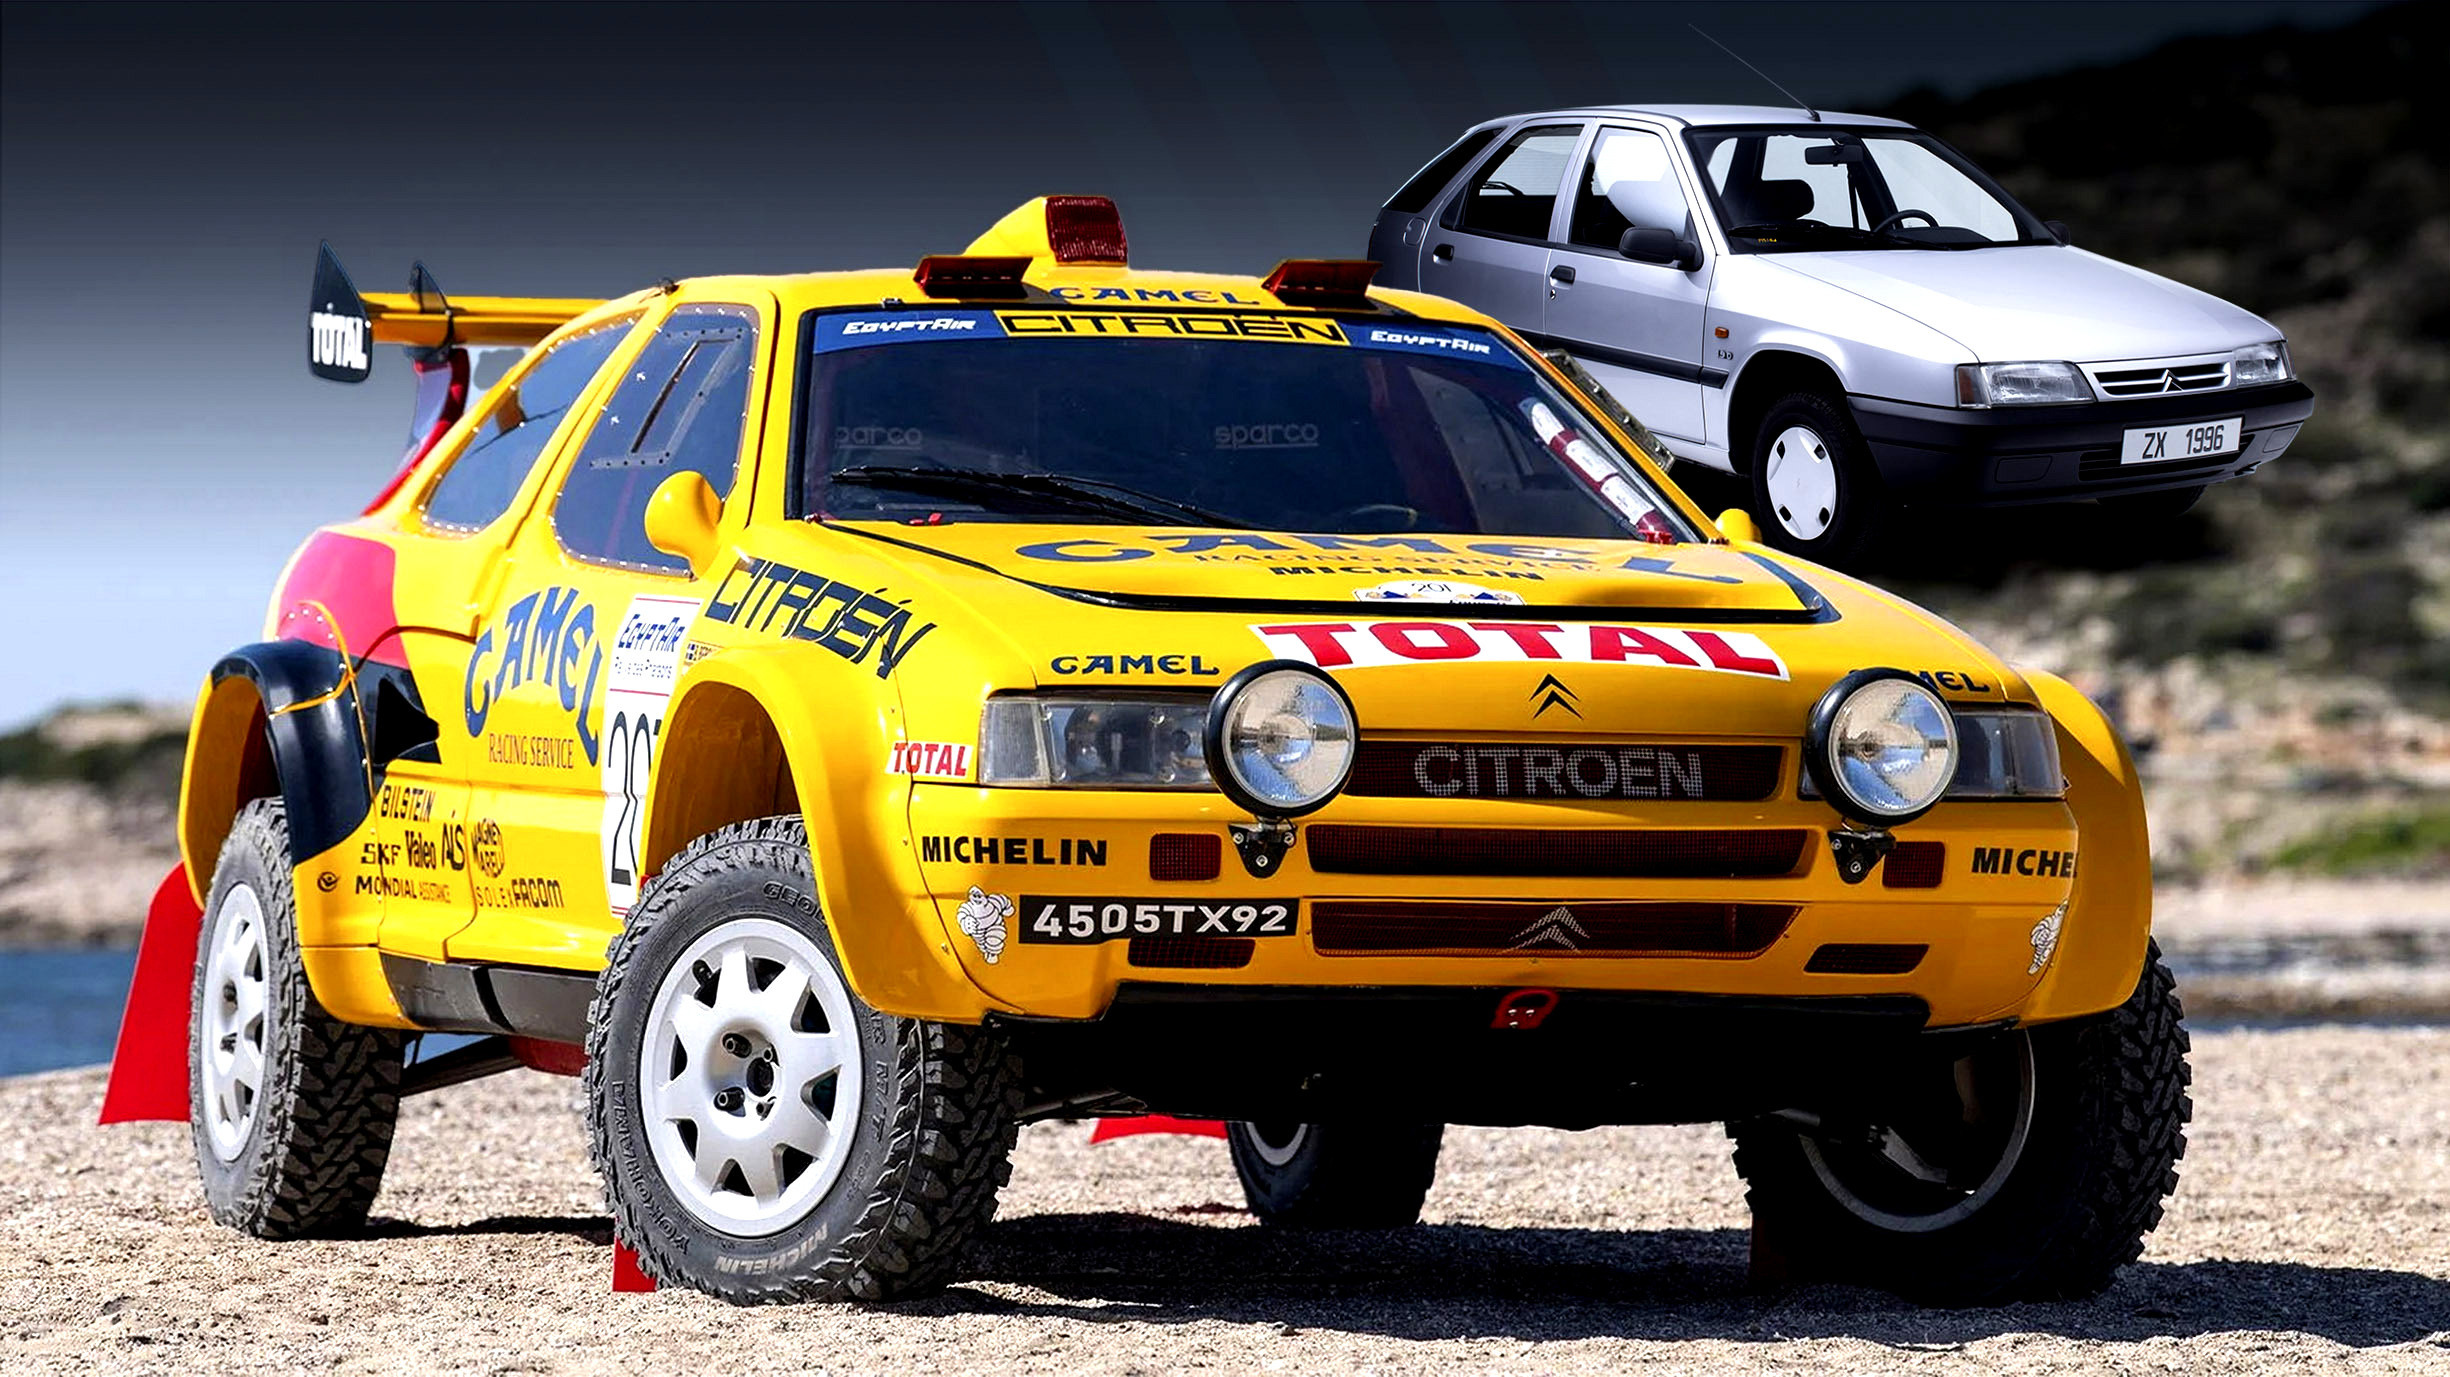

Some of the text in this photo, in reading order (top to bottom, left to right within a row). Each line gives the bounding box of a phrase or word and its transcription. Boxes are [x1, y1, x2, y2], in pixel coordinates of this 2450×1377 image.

[1049, 287, 1260, 305] CAMEL
[311, 311, 368, 370] TOTAL
[834, 426, 923, 450] parco
[1215, 421, 1319, 450] sparco
[2142, 424, 2225, 459] ZX 1996
[1015, 534, 1744, 585] CAMEL
[1268, 566, 1545, 581] MICHELIN
[1051, 654, 1221, 676] CAMEL
[1258, 621, 1782, 677] TOTAL
[464, 586, 603, 767] CAMEL
[488, 732, 575, 770] RACING SERVICE
[892, 742, 969, 777] TOTAL
[1413, 745, 1704, 799] CITROEN
[380, 784, 437, 823] BILSTEIN
[608, 711, 662, 886] 20
[360, 842, 401, 866] SKF
[404, 829, 437, 870] Valeo
[921, 836, 1108, 866] MICHELIN
[1971, 847, 2078, 878] MICHE
[355, 875, 418, 899] MONDIAL
[1033, 904, 1288, 938] 4505TX92
[612, 1080, 691, 1256] YOKOHAMA
[714, 1222, 828, 1275] MICHELIN
